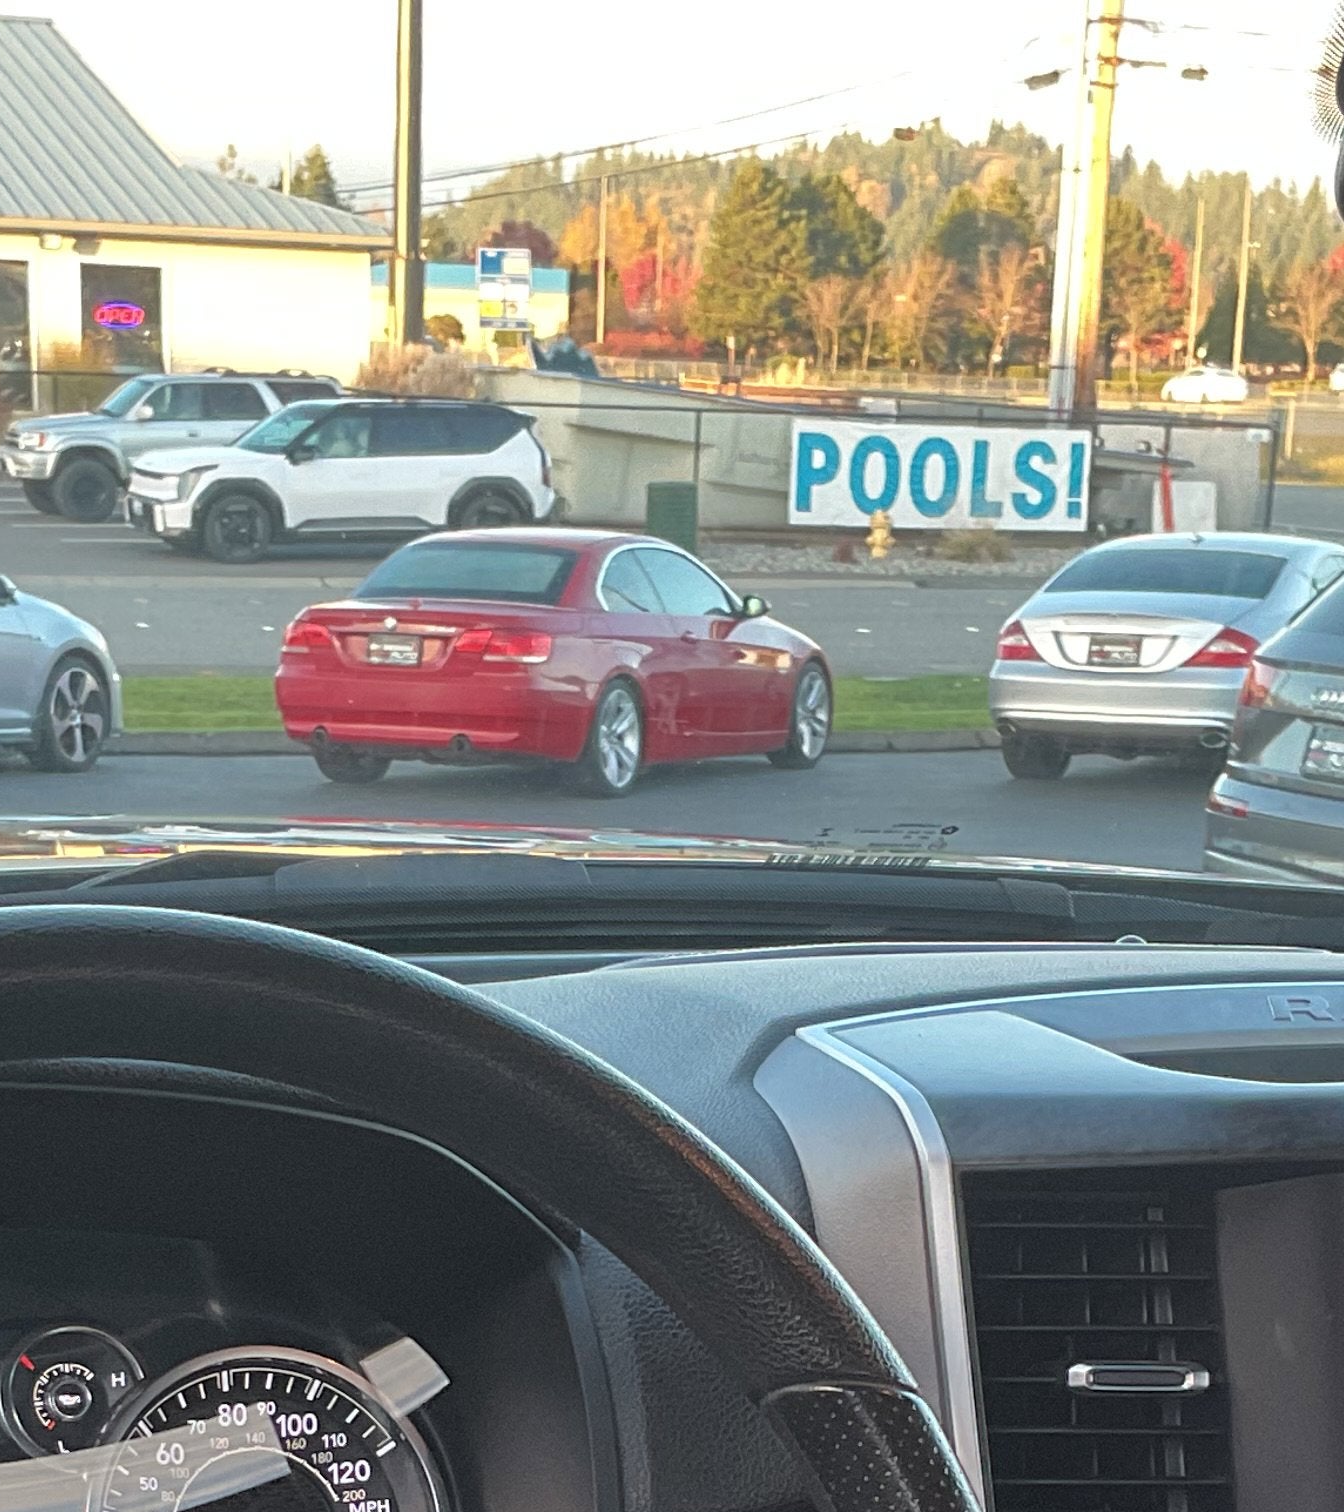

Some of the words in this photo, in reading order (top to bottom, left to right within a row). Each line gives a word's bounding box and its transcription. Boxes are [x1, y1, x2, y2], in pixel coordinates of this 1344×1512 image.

[794, 431, 1086, 521] POOLS!
[111, 1371, 126, 1387] H
[218, 1403, 248, 1427] 80
[256, 1401, 276, 1416] 90
[187, 1419, 207, 1435] 70
[276, 1413, 318, 1438] 100
[209, 1437, 230, 1449] 120
[245, 1432, 266, 1444] 140
[285, 1438, 306, 1450] 160
[321, 1433, 348, 1449] 110
[58, 1440, 71, 1453] L
[156, 1443, 185, 1466] 60
[311, 1452, 334, 1464] 180
[328, 1459, 371, 1485] 120
[139, 1476, 158, 1491] 50
[342, 1490, 366, 1503] 200
